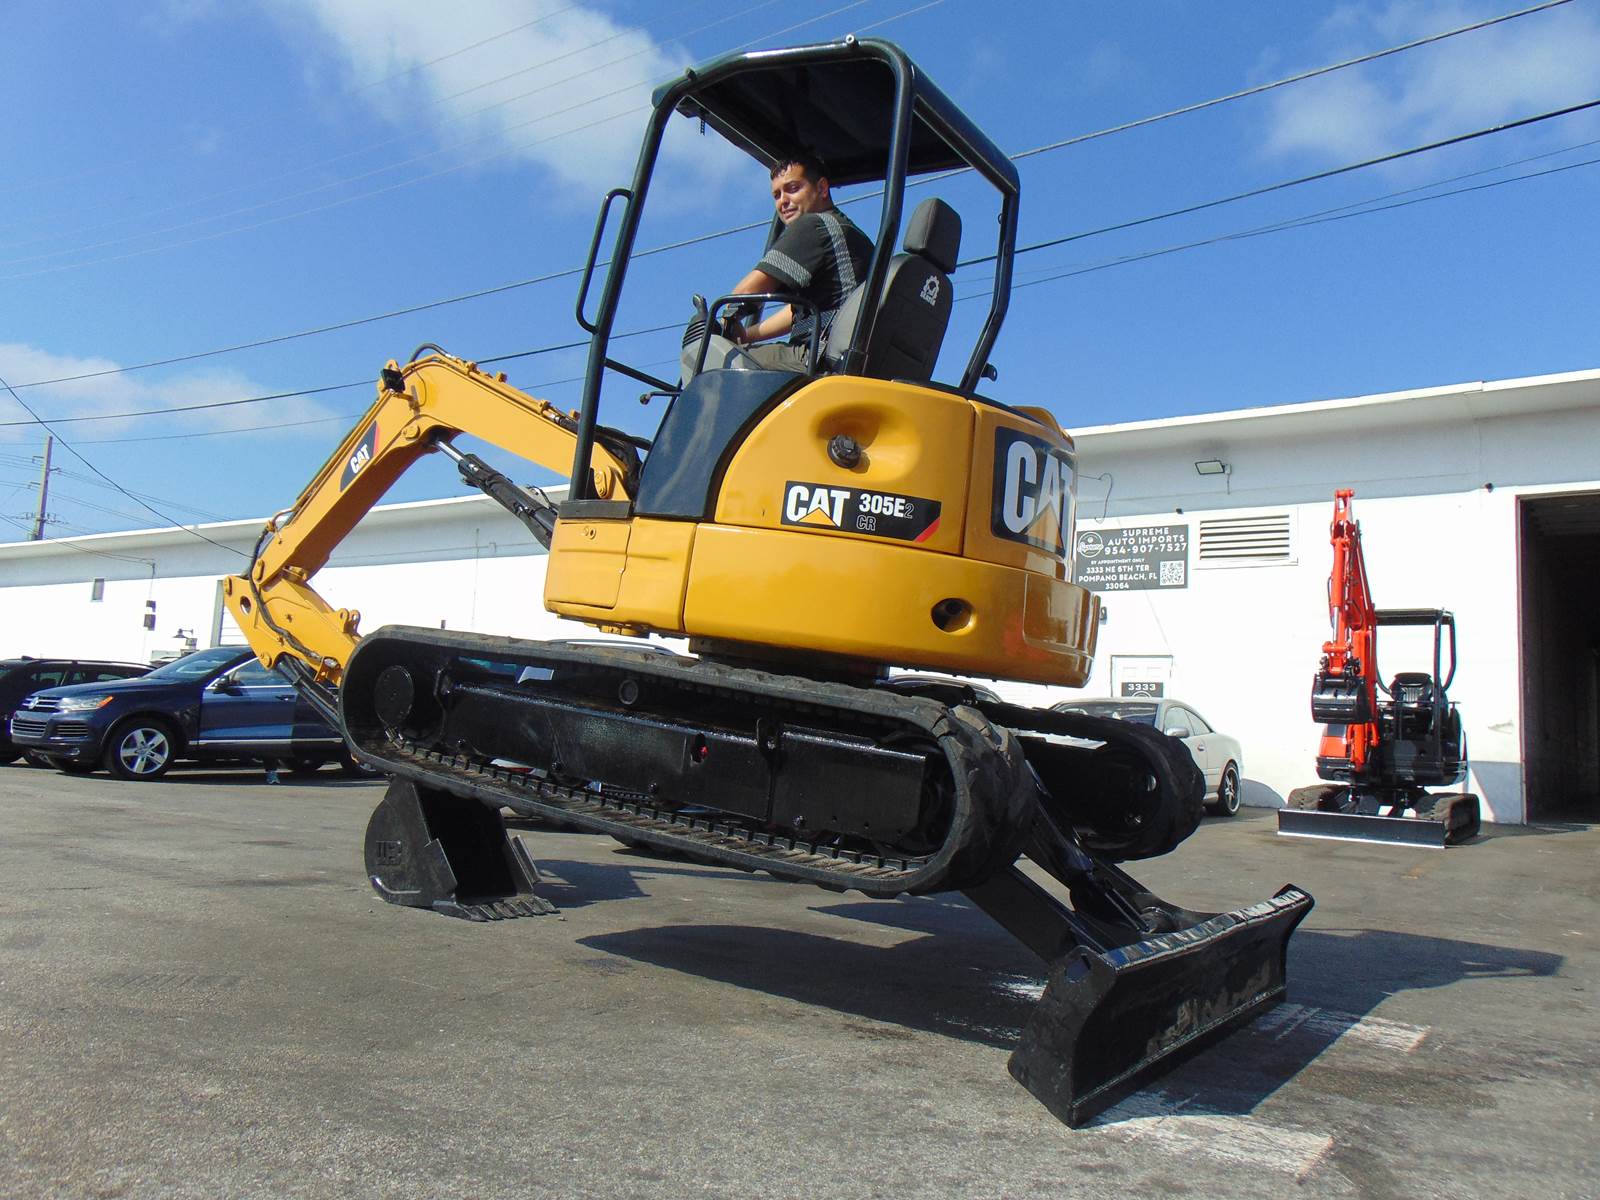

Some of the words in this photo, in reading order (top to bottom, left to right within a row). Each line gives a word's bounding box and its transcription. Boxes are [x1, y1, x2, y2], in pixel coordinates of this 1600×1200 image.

[350, 444, 370, 474] CAT
[1003, 441, 1075, 557] CAT
[786, 485, 850, 527] CAT
[856, 515, 876, 531] CR
[1122, 527, 1169, 537] SUPREME
[1107, 538, 1136, 546] AUTO
[1138, 534, 1185, 544] IMPORTS
[1104, 543, 1187, 555] 954-907-7527
[1120, 573, 1147, 581] BEACH,
[1105, 582, 1130, 590] 33064
[1128, 683, 1156, 691] 3333
